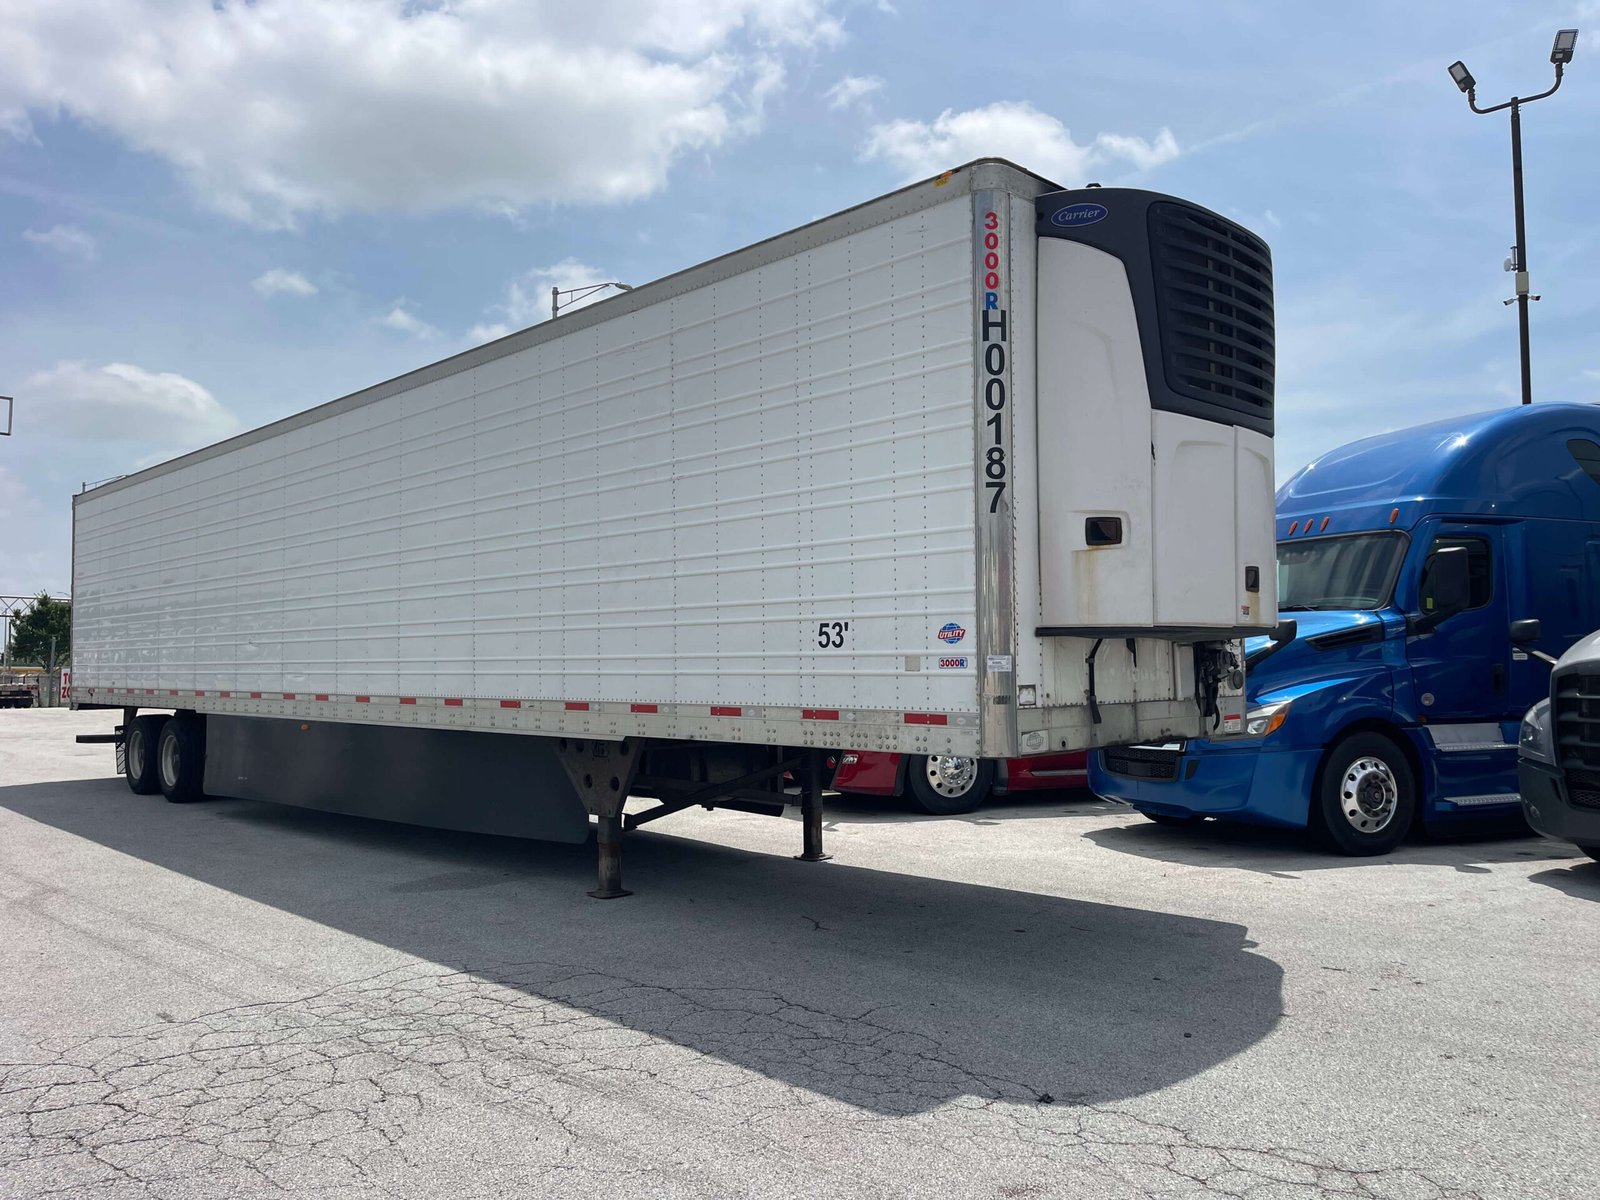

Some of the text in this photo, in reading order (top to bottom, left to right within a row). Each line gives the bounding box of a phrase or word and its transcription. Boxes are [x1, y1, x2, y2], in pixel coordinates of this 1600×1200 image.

[1058, 209, 1100, 221] Carrier
[984, 212, 999, 310] 3000R
[982, 310, 1007, 513] H00187
[818, 621, 849, 648] 53'
[939, 630, 964, 639] UTILITY
[940, 659, 965, 667] 3000R
